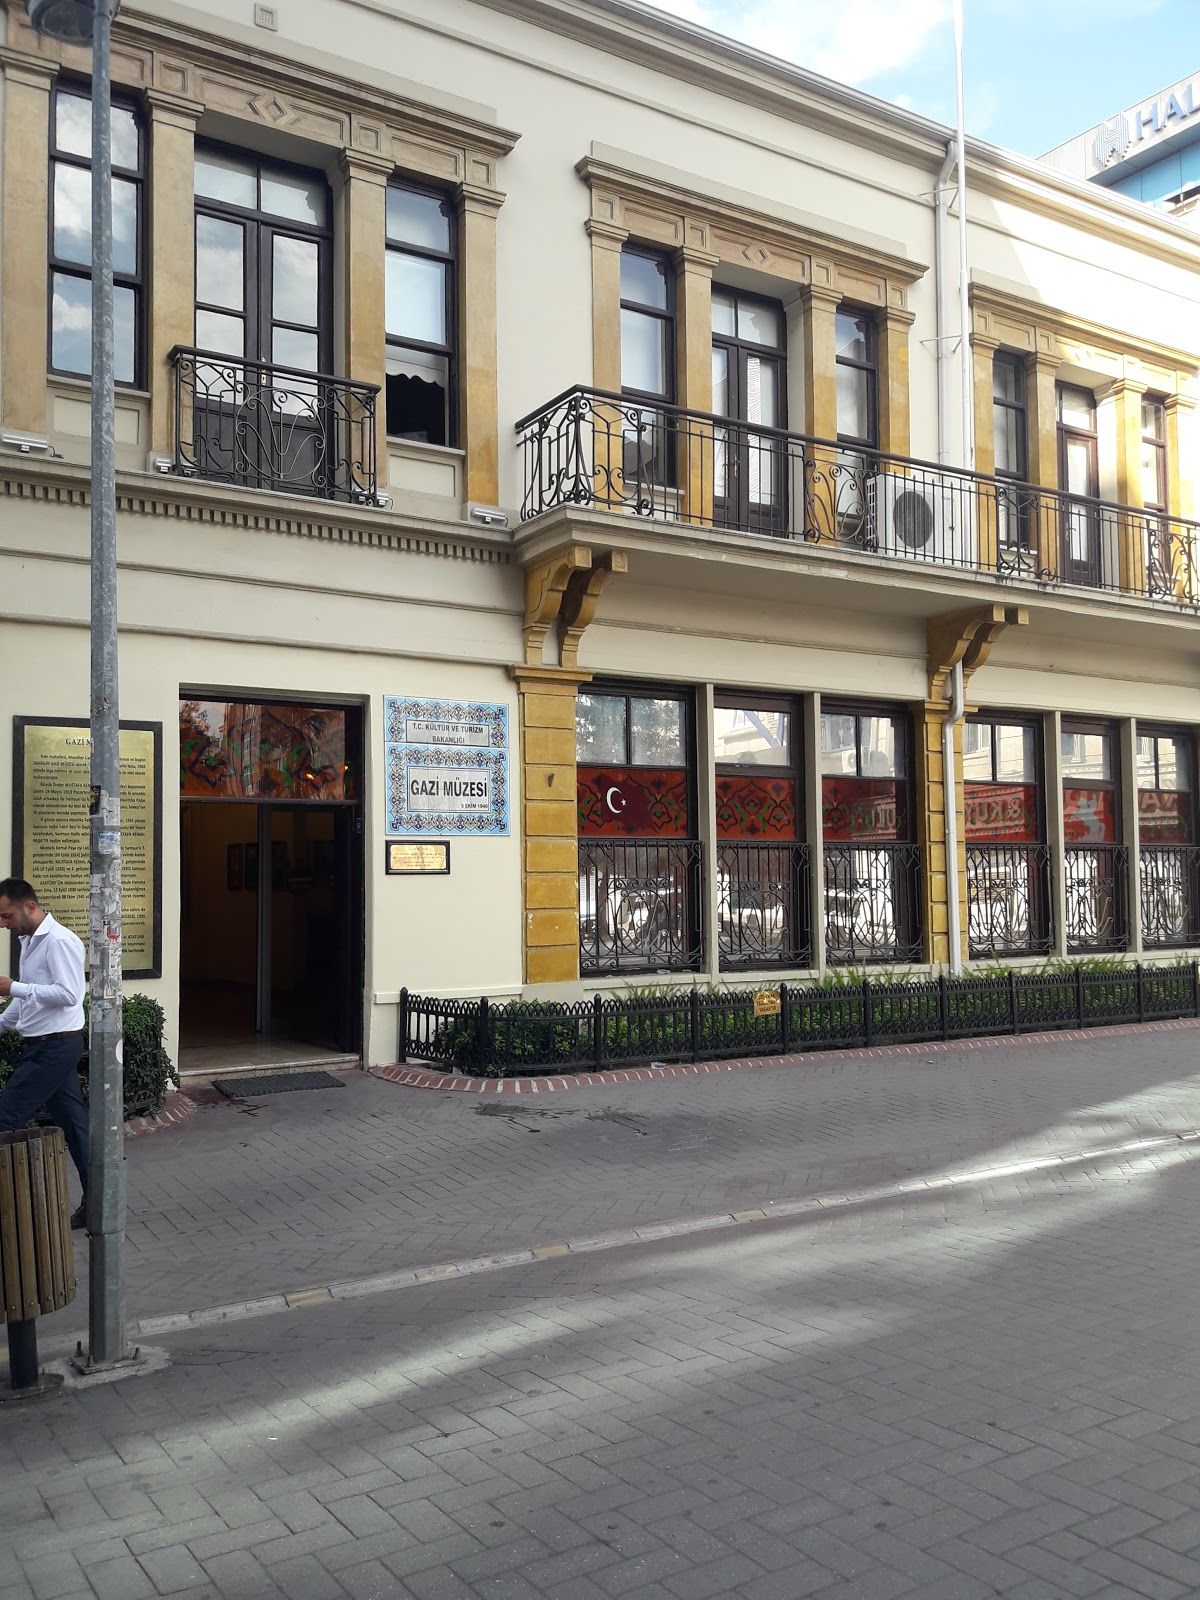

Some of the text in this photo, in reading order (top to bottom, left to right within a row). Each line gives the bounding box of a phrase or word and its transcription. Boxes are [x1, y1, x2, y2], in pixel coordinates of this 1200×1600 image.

[425, 723, 450, 732] KÜLTÜR
[460, 725, 484, 733] TURİZM
[432, 735, 465, 743] BAKANLIĞI
[411, 776, 488, 797] GAZİ MÜZESİ
